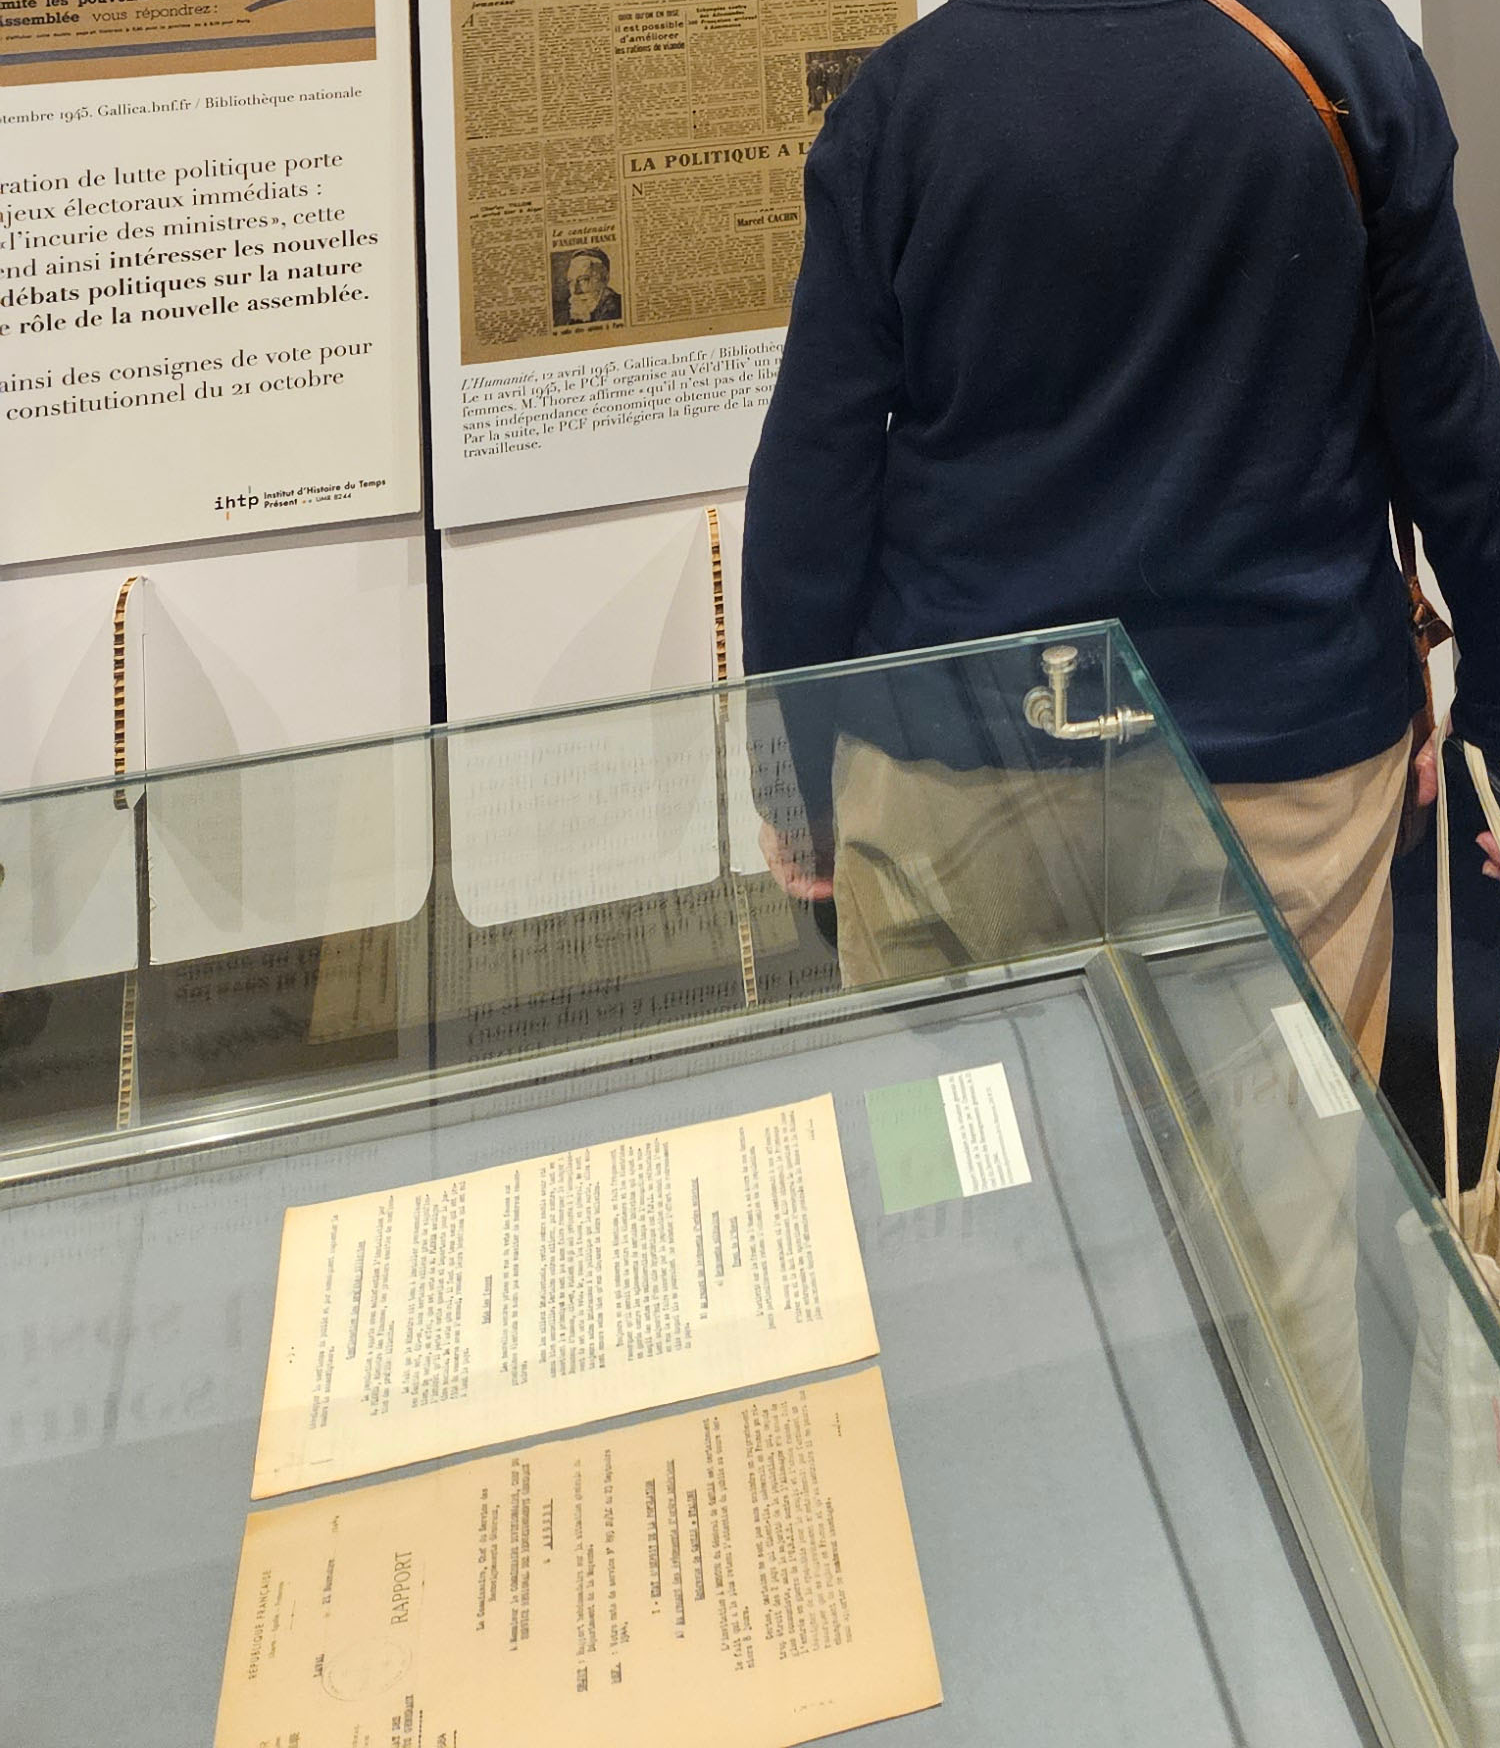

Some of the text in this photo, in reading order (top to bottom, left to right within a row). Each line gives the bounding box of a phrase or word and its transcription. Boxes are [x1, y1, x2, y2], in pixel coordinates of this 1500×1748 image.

[630, 143, 790, 172] LA POLITIQUE A
[0, 262, 363, 308] débats politiques sur la nature
[20, 313, 67, 334] rôle
[74, 309, 103, 328] de
[111, 306, 132, 325] la
[141, 295, 239, 322] nouvelle
[247, 283, 369, 312] assemblée.
[6, 382, 185, 421] constitutionnel
[194, 380, 223, 399] du
[259, 368, 344, 392] octobre
[463, 439, 542, 459] travailleuse.
[214, 494, 259, 510] ihtp
[264, 499, 297, 508] Présent
[391, 1551, 412, 1625] RAPPORT
